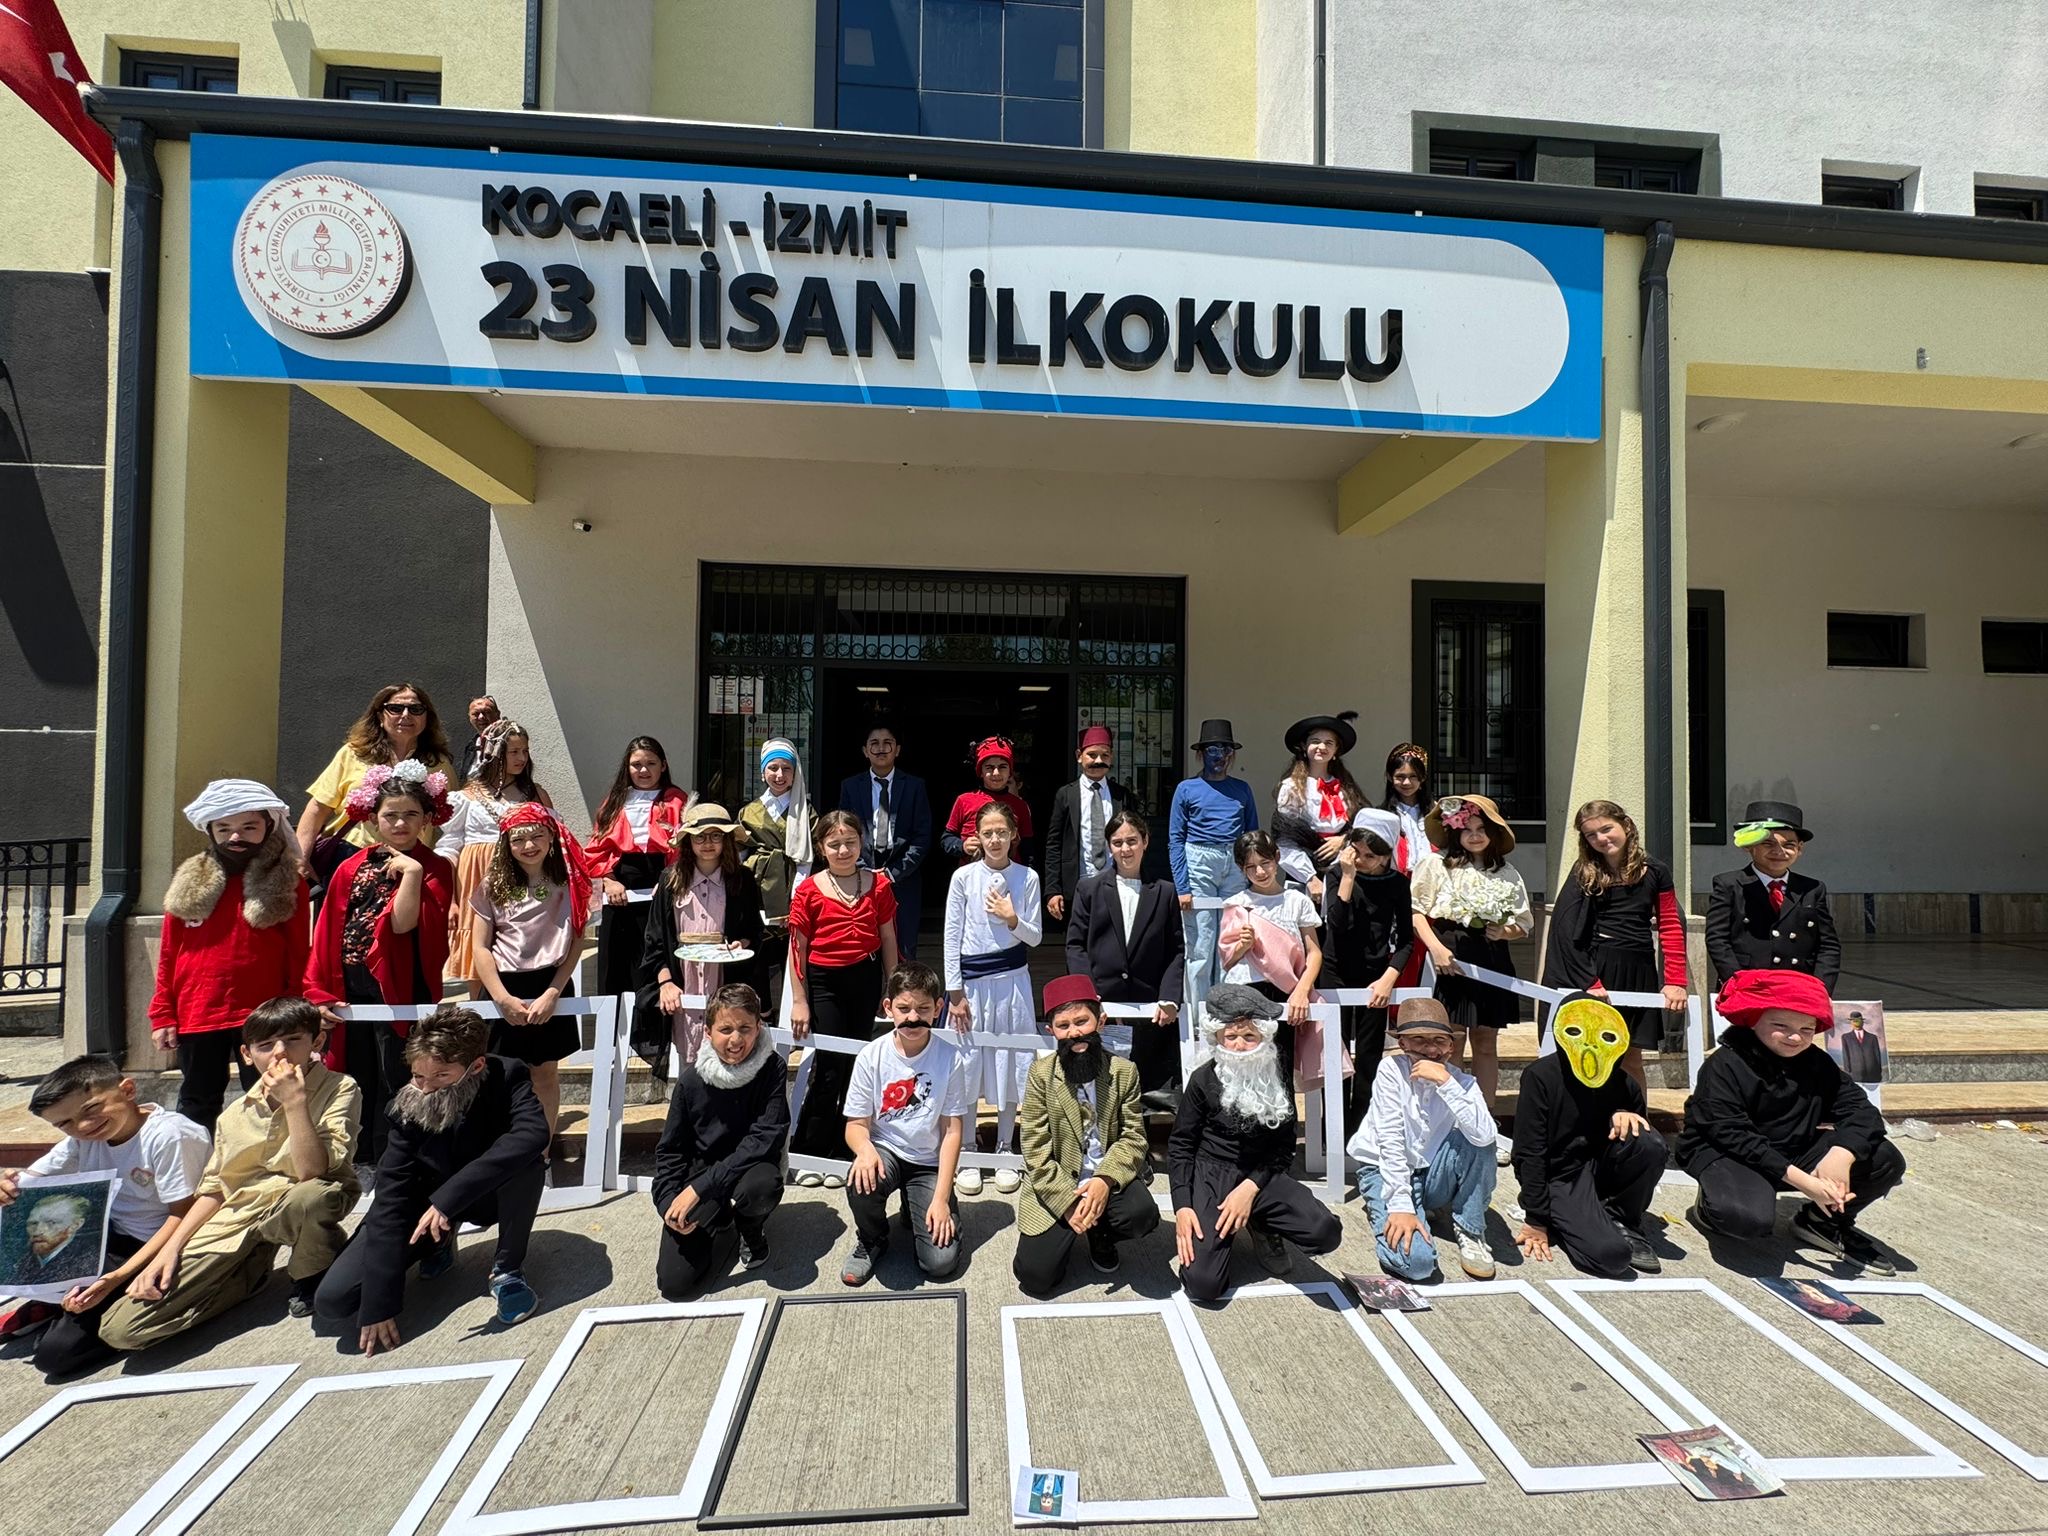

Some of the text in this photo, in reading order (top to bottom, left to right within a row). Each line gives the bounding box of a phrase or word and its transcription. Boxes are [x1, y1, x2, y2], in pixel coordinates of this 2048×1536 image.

[271, 204, 373, 302] TÜRKİYE CUMHURİYETİ MİLLİ EĞİTİM BAKANLIĞI
[482, 184, 716, 248] KOCAELİ
[763, 191, 908, 259] İZMİT
[479, 250, 1404, 383] 23 NİSAN İLKOKULU
